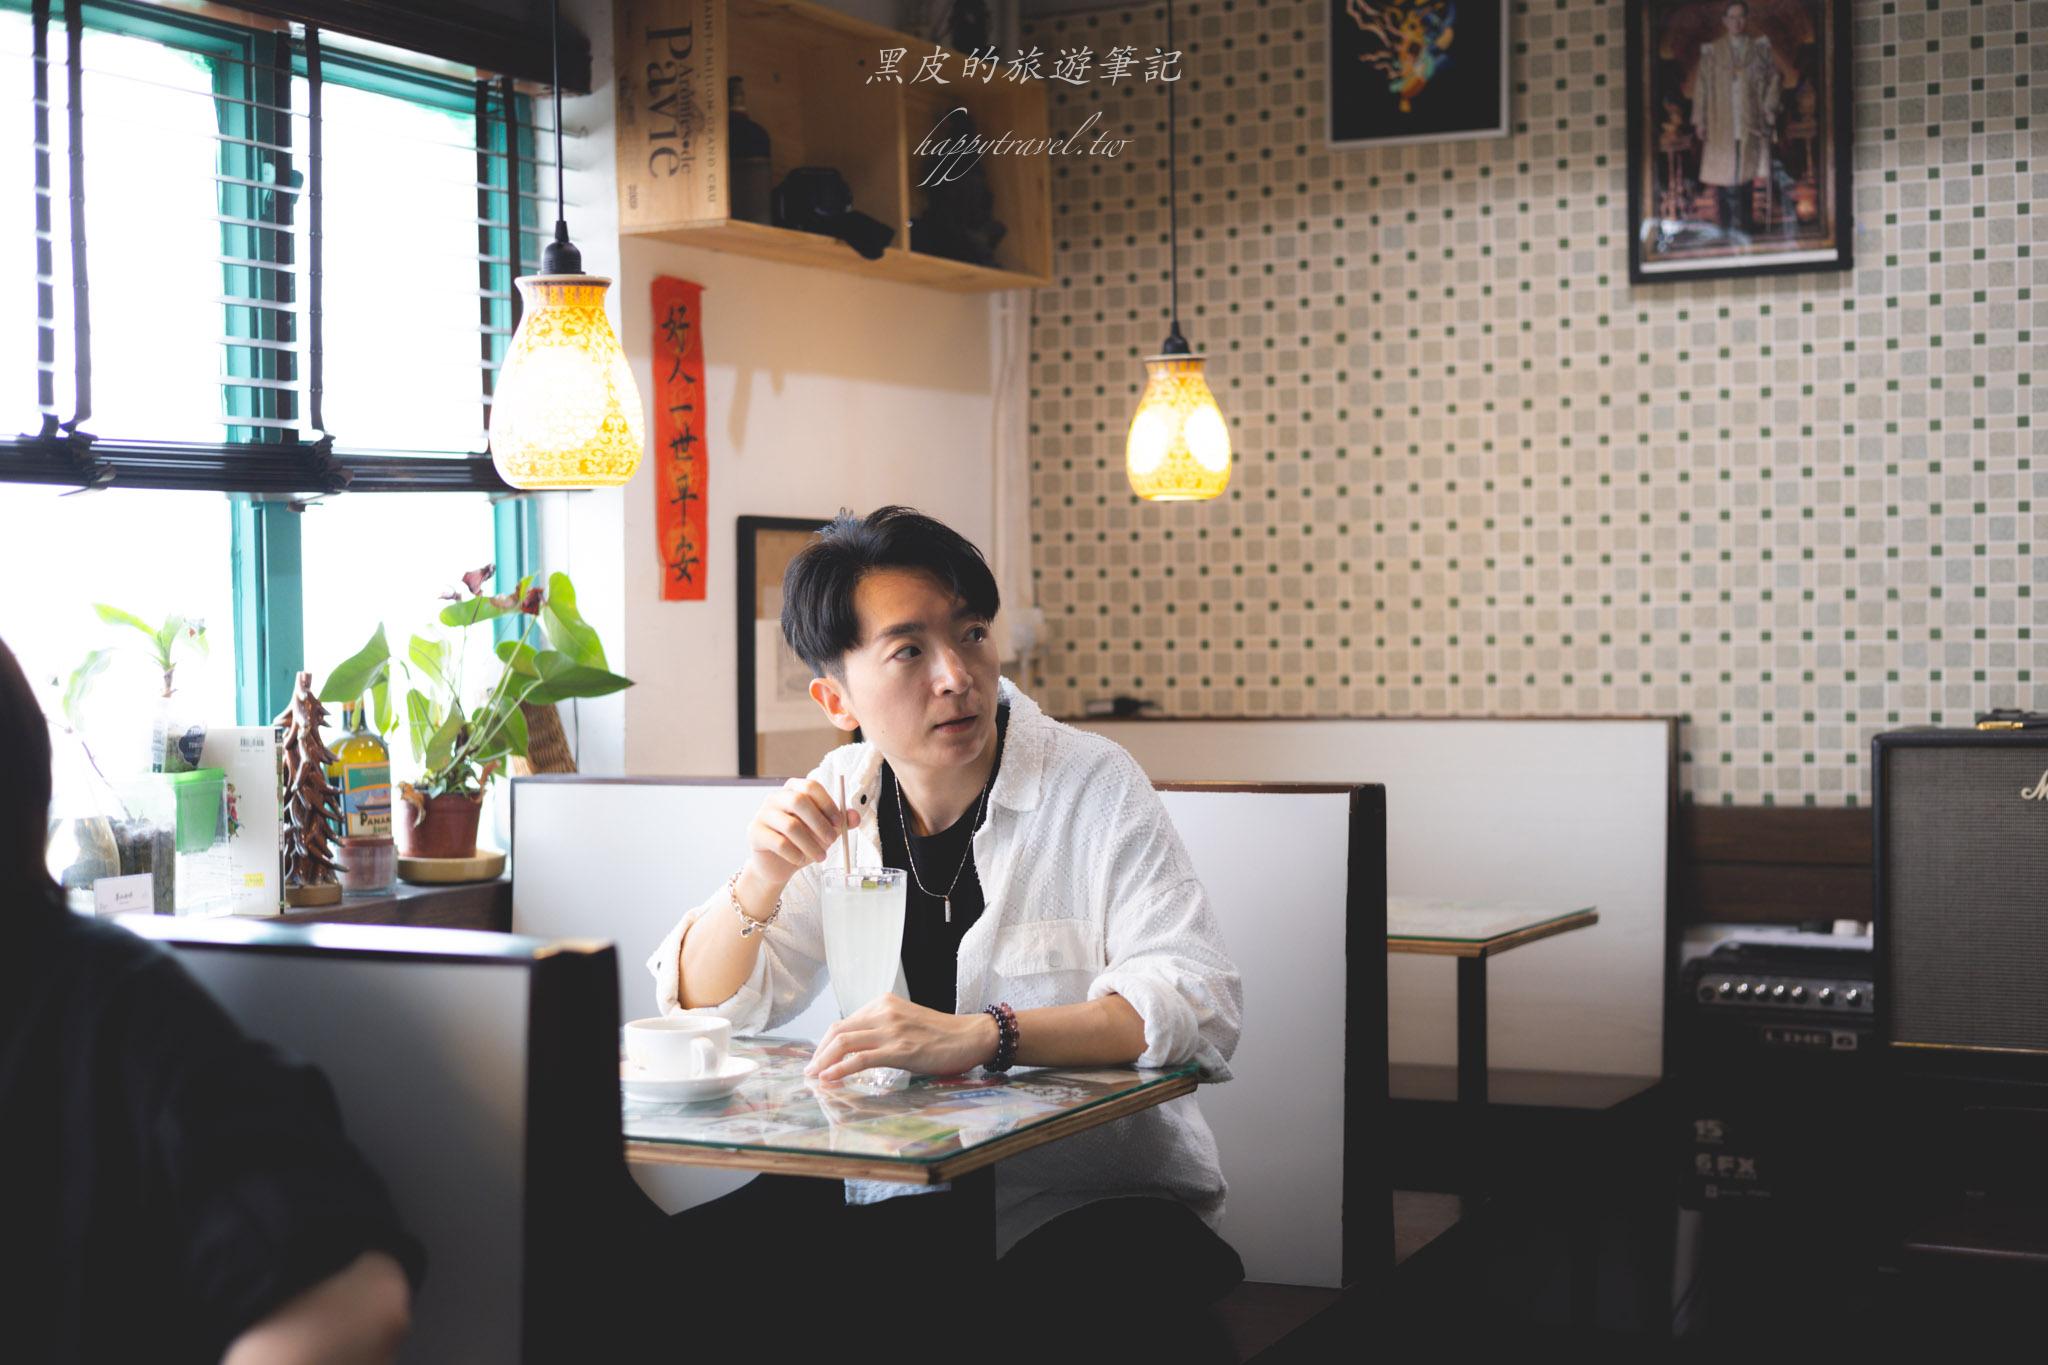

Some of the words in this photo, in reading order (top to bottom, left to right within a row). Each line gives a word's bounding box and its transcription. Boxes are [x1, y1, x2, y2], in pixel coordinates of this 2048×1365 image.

[645, 20, 693, 178] Pavie
[662, 305, 699, 581] 好人一世平安
[1693, 1119, 1724, 1137] 15
[1695, 1153, 1712, 1170] 6
[1717, 1155, 1755, 1173] FX
